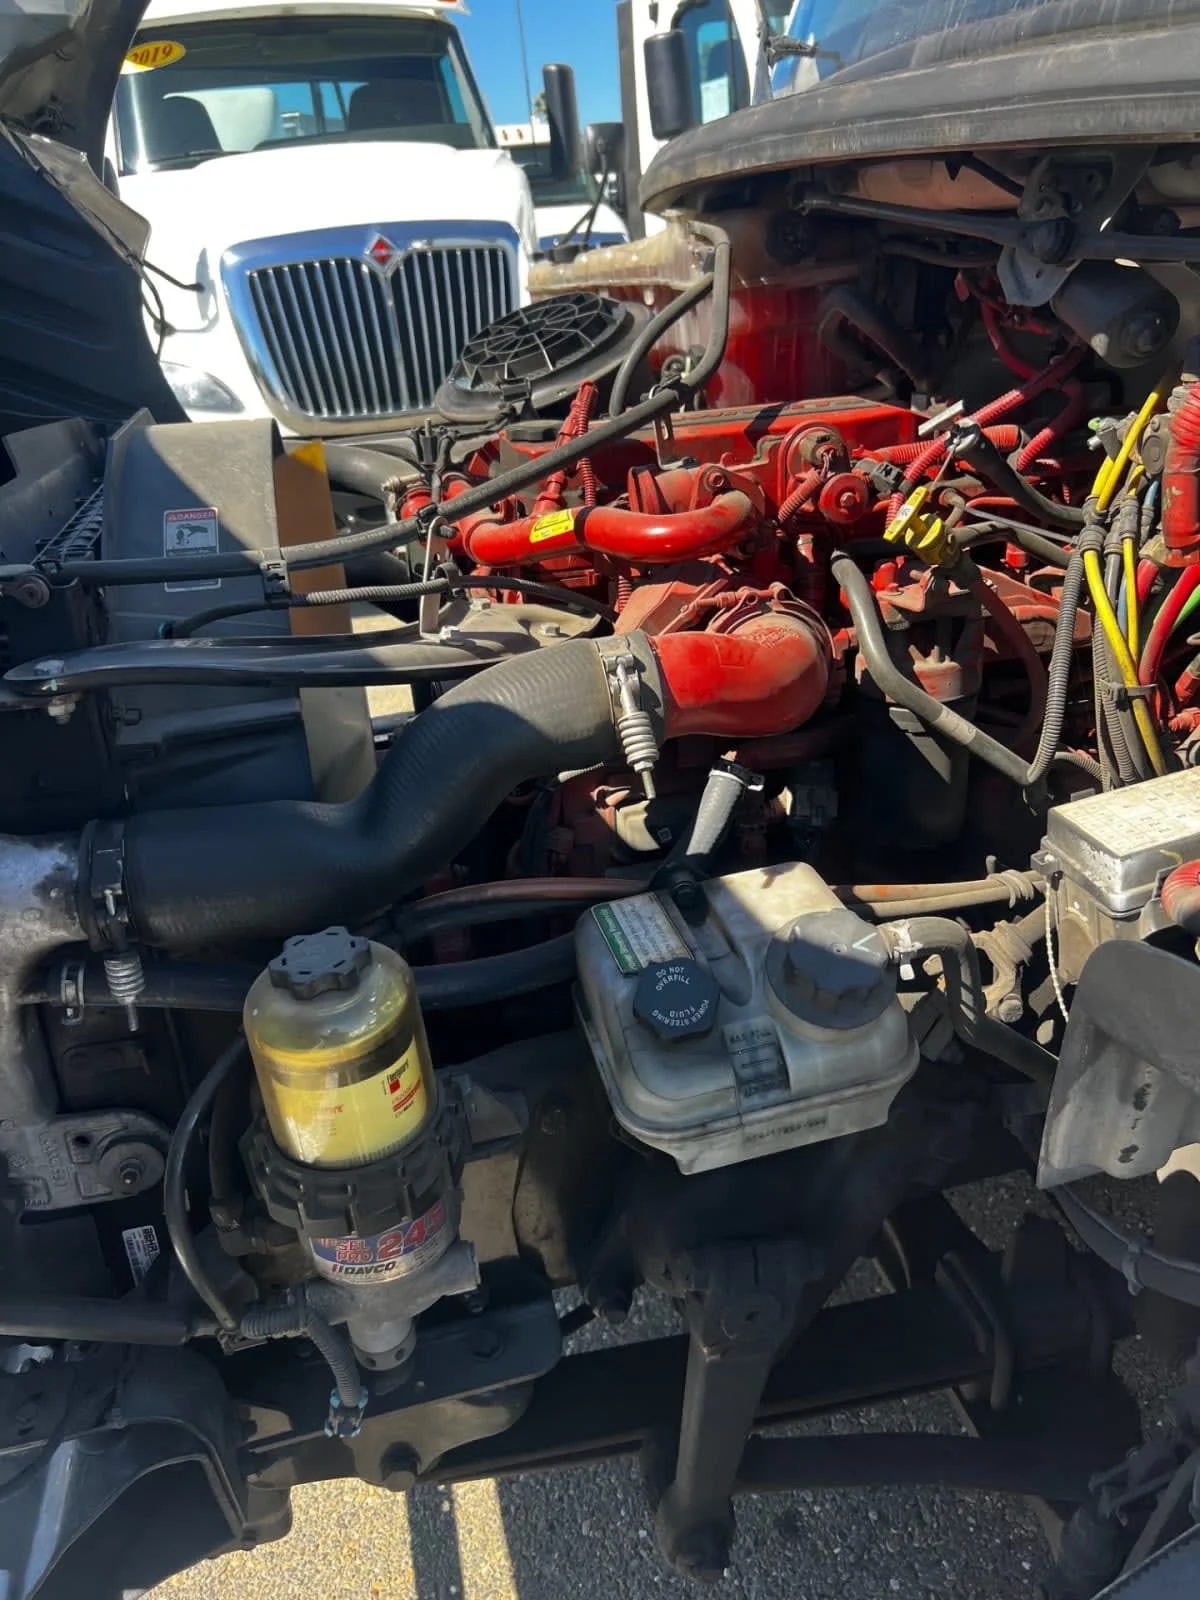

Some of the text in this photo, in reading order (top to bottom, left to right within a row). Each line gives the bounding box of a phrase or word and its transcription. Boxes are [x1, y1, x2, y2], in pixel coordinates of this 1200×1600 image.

[131, 44, 173, 65] 2019
[177, 511, 215, 521] DANGER
[655, 966, 685, 978] DO NOT
[655, 974, 690, 991] OVERFILL
[651, 999, 710, 1027] POWER STEERING
[669, 1005, 696, 1018] FLUID
[336, 1250, 373, 1263] PRO
[343, 1260, 397, 1275] DAVCO
